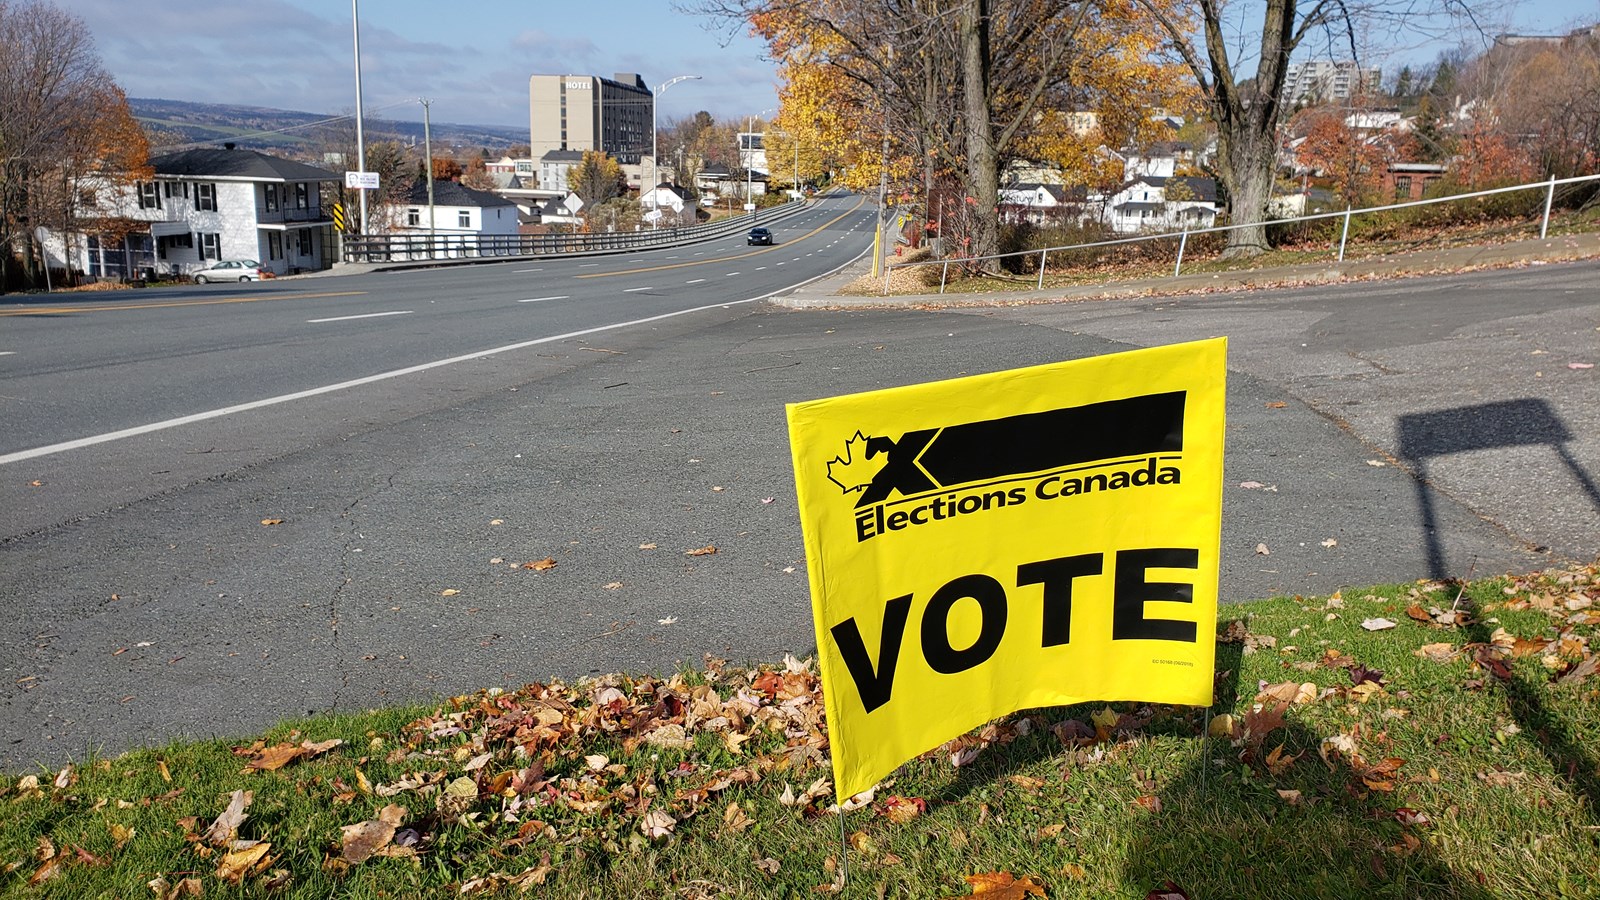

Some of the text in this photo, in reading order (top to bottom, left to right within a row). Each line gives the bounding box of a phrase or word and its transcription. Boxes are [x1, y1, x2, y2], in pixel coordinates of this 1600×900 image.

[855, 457, 1182, 543] Elections Canada
[831, 548, 1199, 714] VOTE
